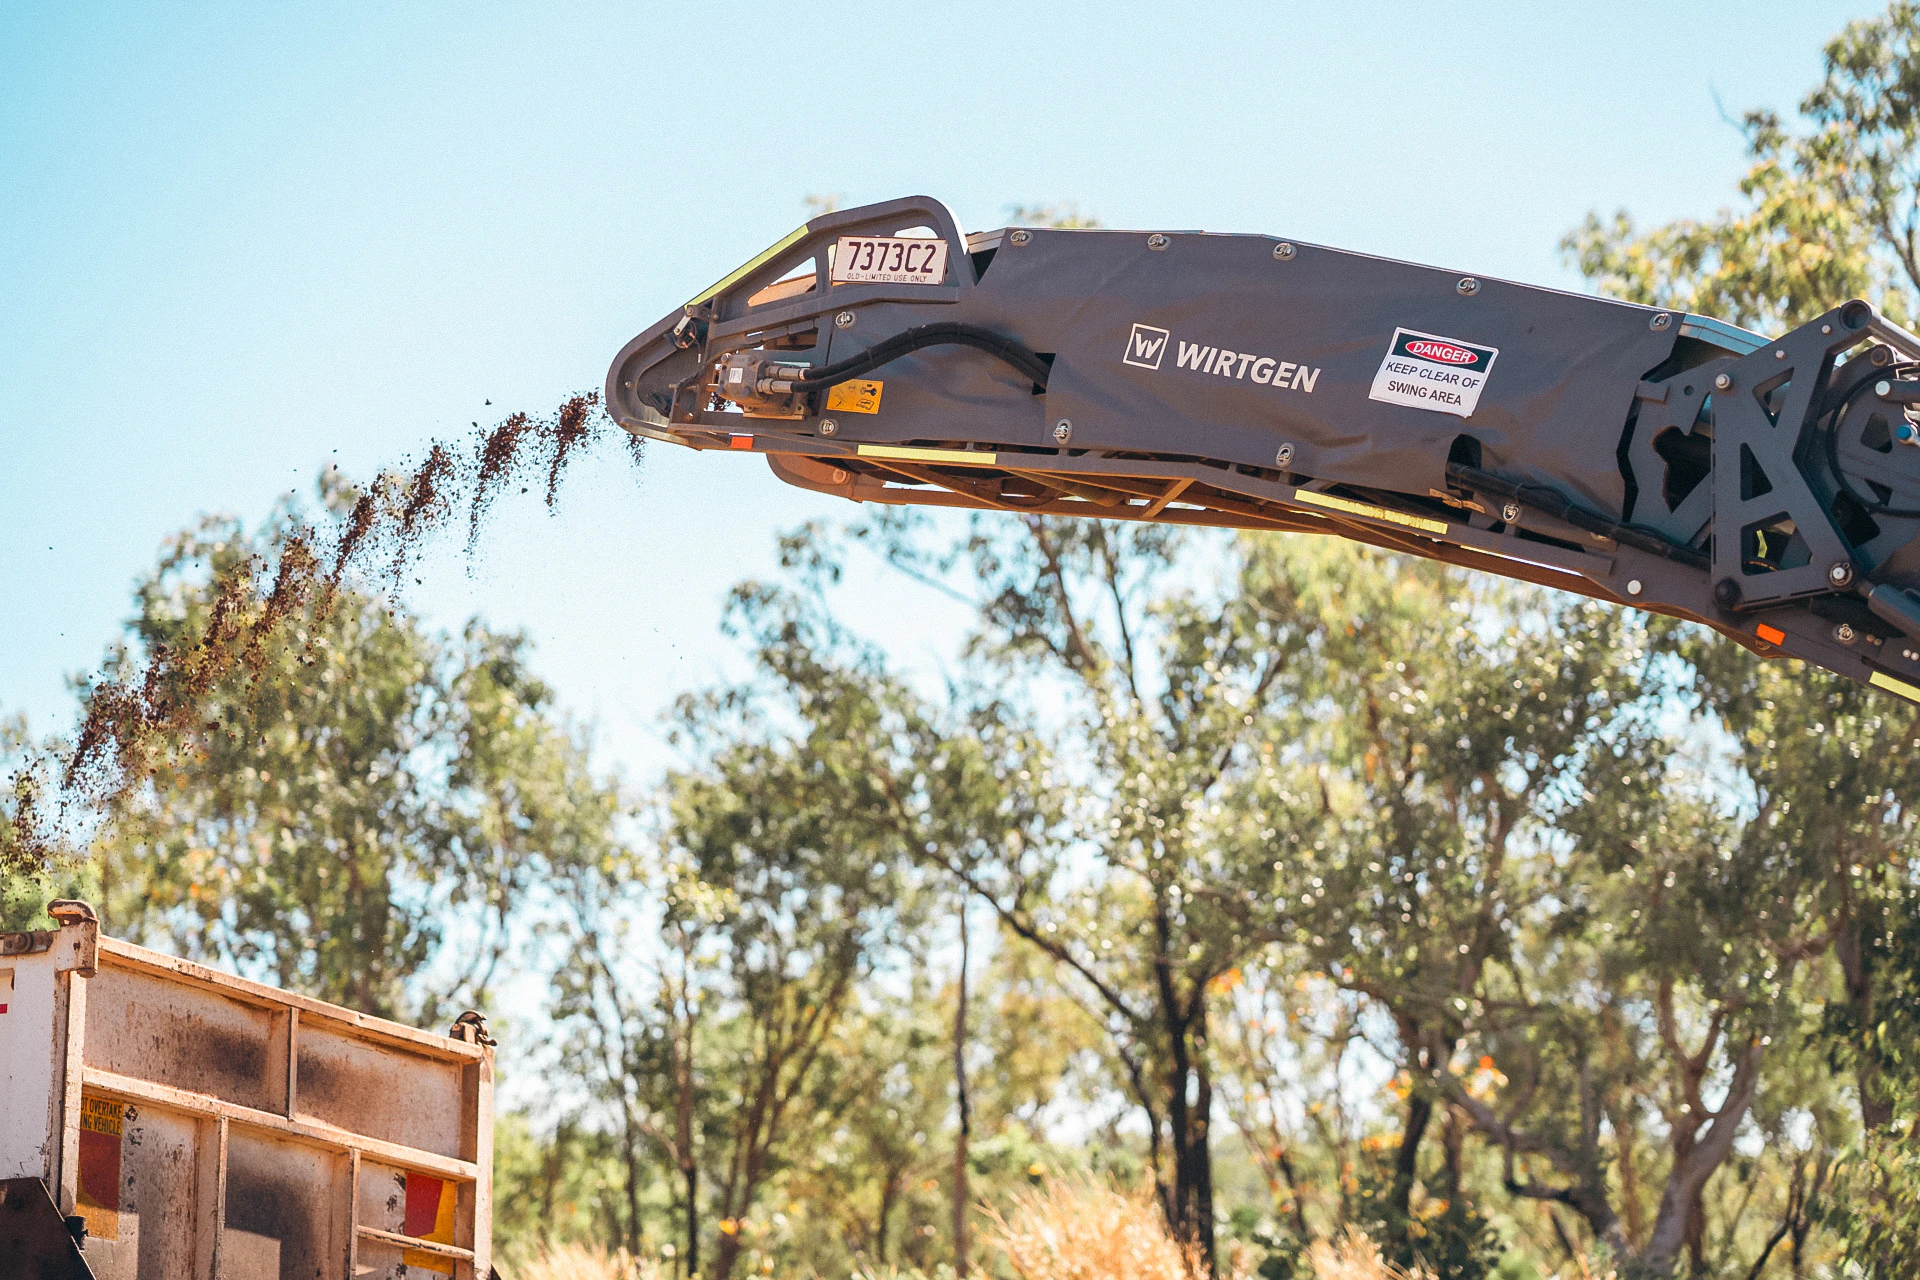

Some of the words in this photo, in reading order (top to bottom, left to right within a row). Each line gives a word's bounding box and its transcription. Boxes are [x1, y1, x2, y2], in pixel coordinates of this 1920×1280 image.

[848, 241, 937, 274] 7373C2
[894, 274, 907, 282] USE
[1135, 332, 1163, 359] W
[1176, 340, 1321, 393] WIRTGEN
[1412, 342, 1472, 363] DANGER
[1386, 361, 1418, 376] KEEP
[1419, 368, 1460, 385] CLEAR
[1462, 377, 1480, 389] OF
[1388, 380, 1428, 398] SWING
[1429, 389, 1462, 406] AREA
[90, 1099, 122, 1119] OVERTAKE
[93, 1115, 121, 1135] VEHICLE
